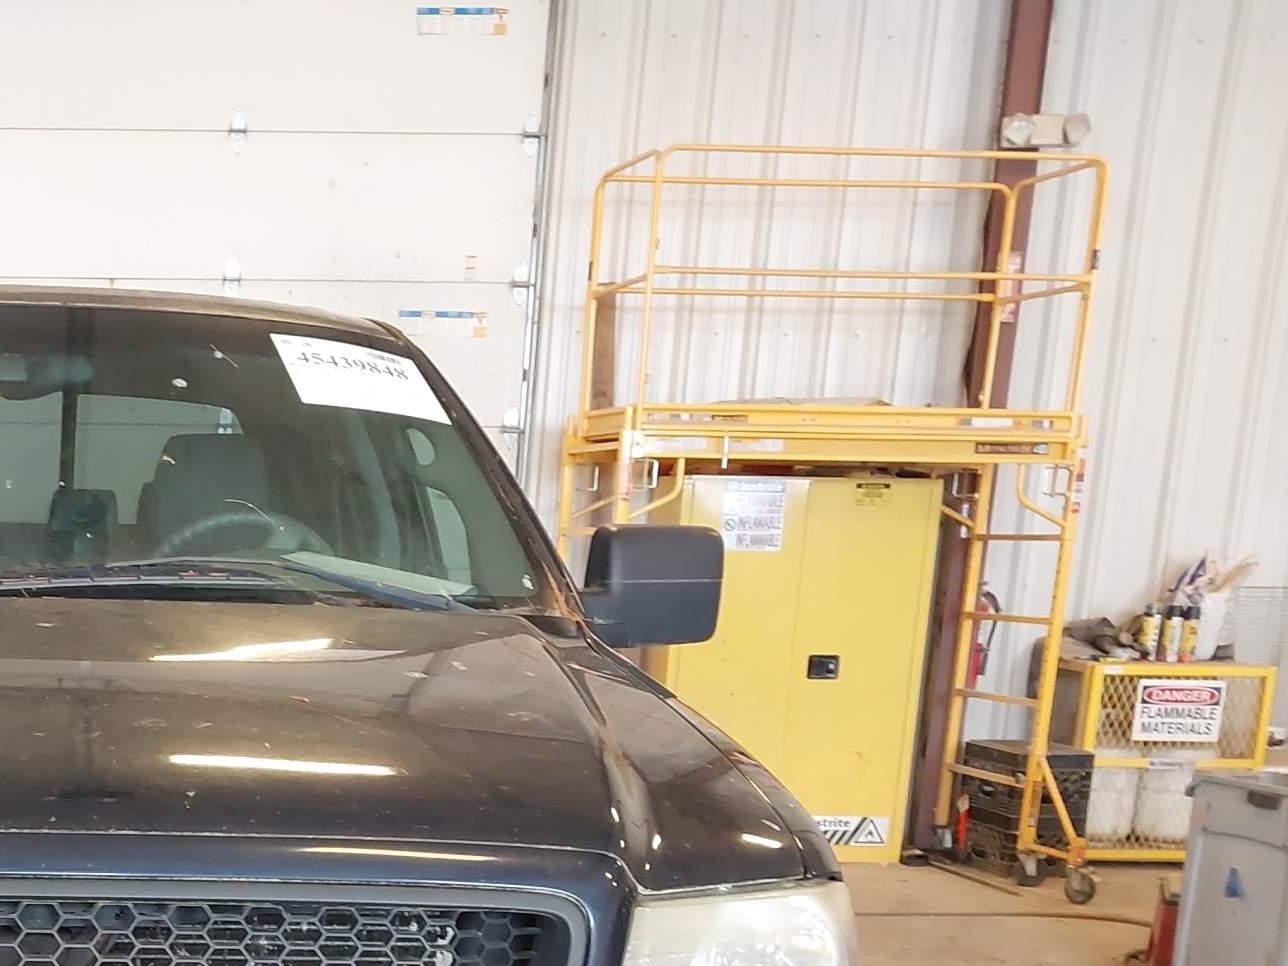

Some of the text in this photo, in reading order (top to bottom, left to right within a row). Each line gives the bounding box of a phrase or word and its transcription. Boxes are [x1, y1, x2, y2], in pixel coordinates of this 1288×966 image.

[296, 351, 410, 381] 45439848
[1151, 690, 1211, 702] DANGER
[1141, 706, 1218, 721] FLAMMABLE
[1140, 722, 1213, 736] MATERIALS
